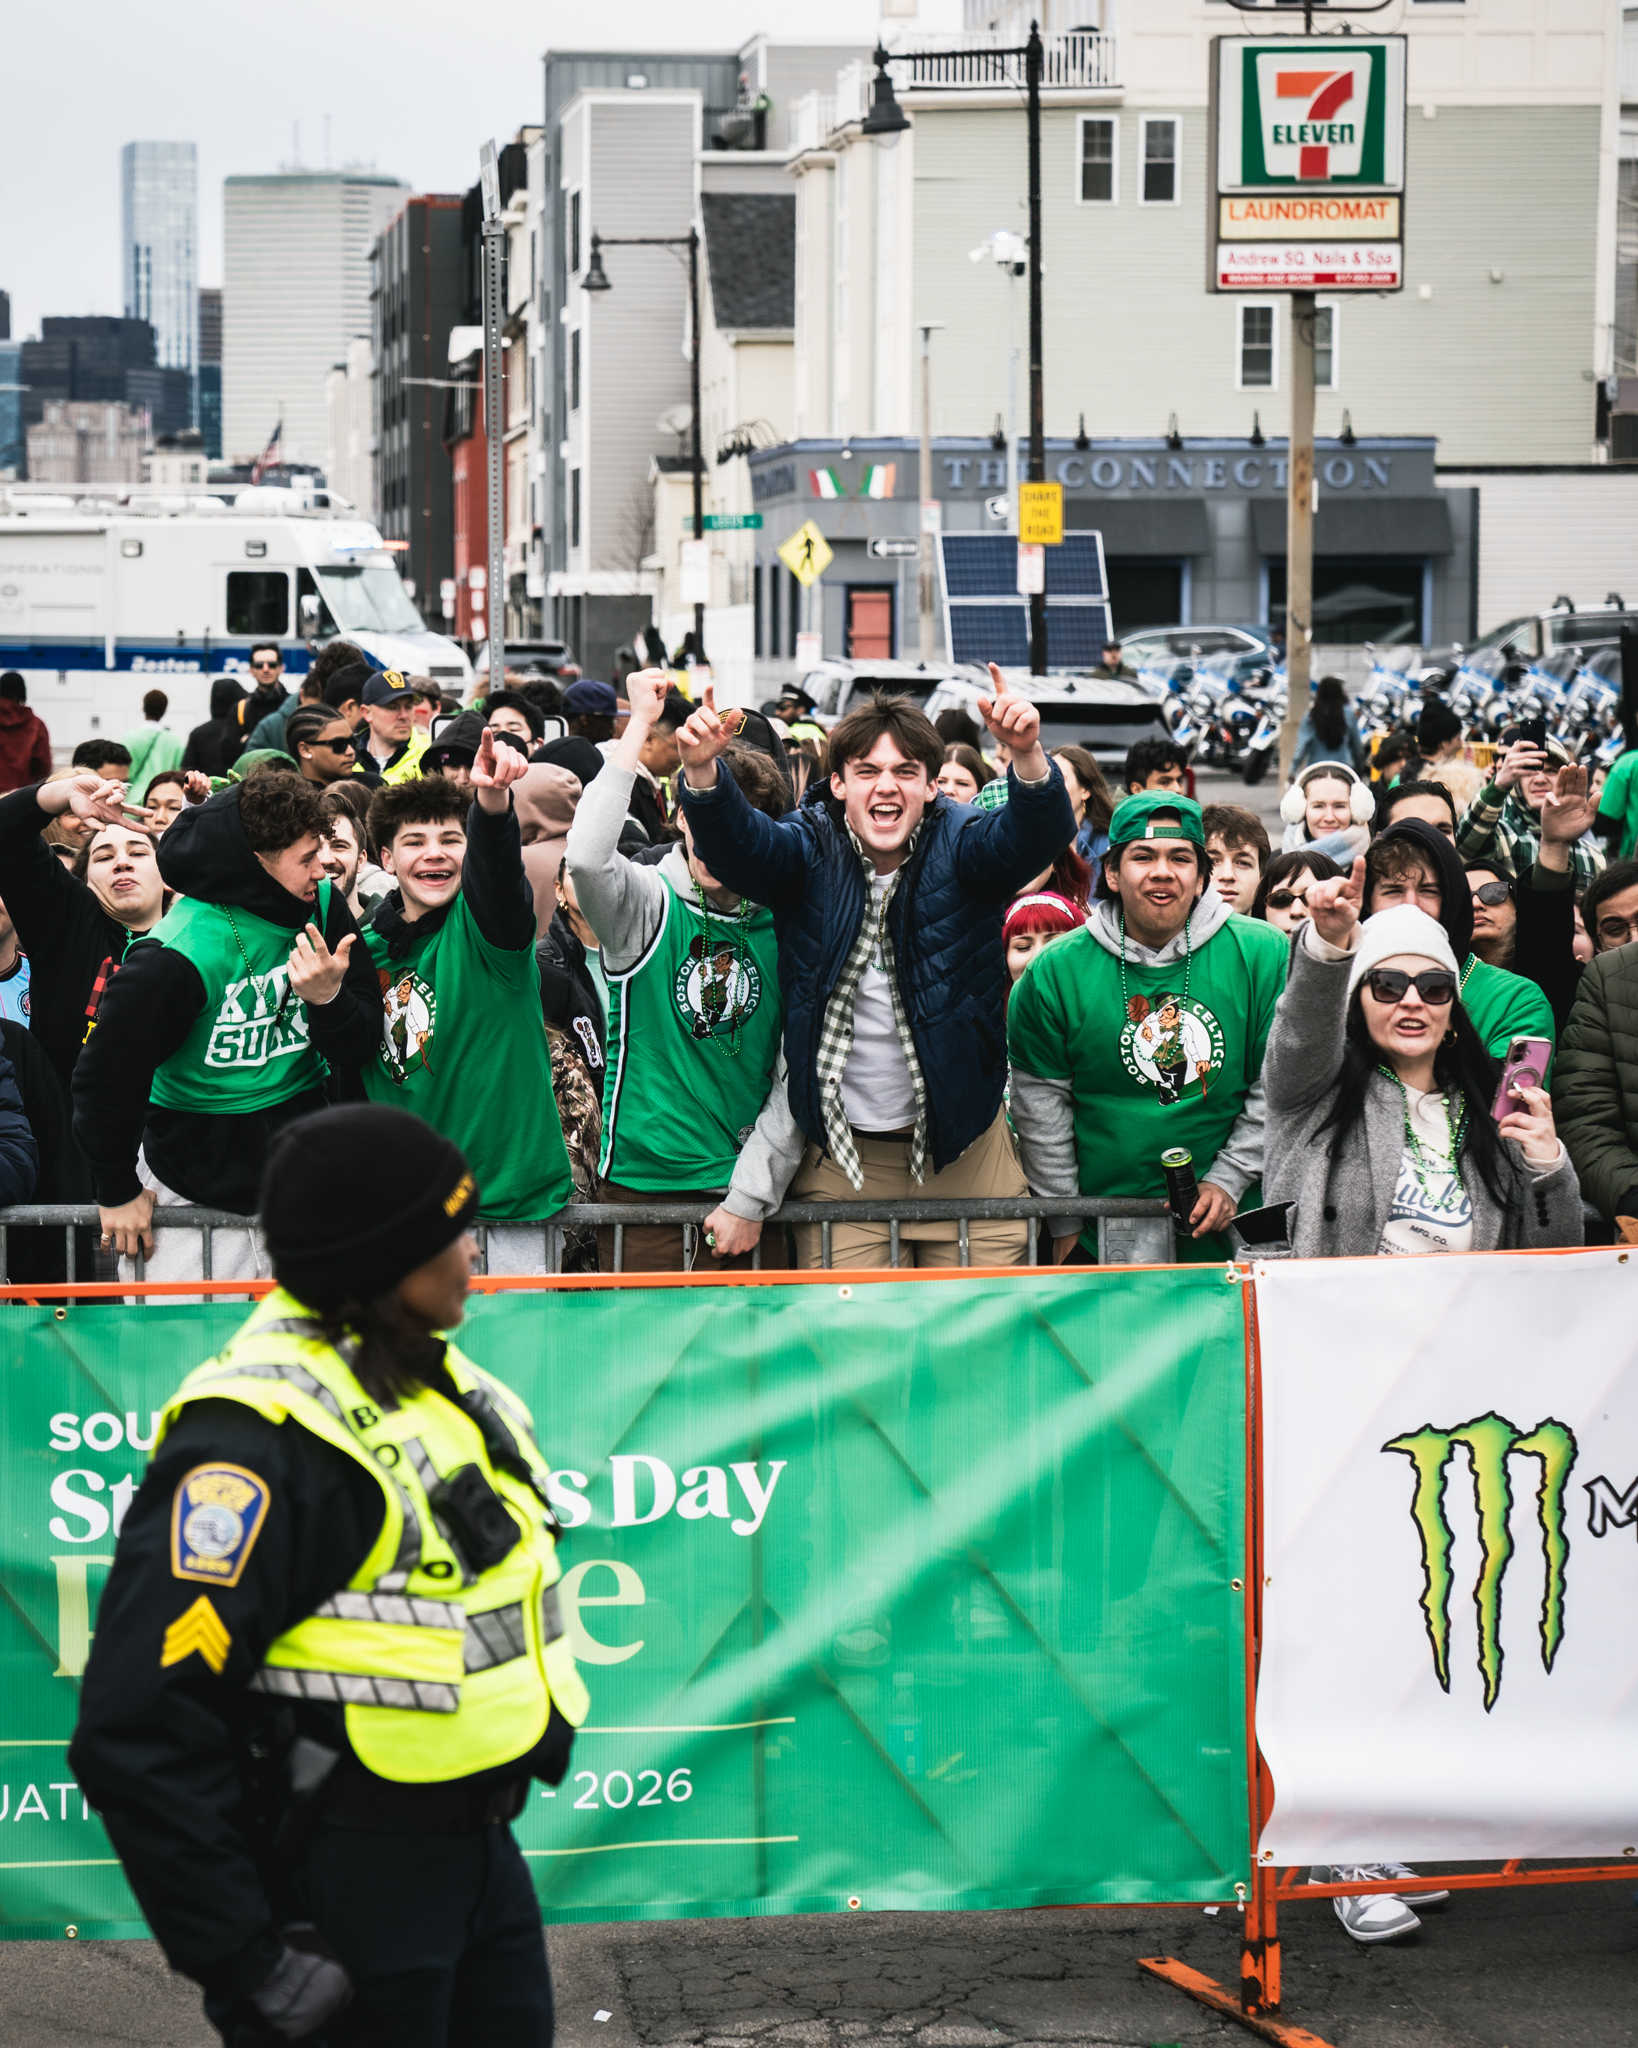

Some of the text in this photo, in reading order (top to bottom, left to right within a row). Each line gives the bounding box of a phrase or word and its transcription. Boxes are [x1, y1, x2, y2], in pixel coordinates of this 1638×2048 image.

[1276, 70, 1354, 179] 7
[1228, 201, 1390, 221] LAUNDROMAT
[1228, 250, 1280, 266] Andrew
[1313, 250, 1347, 266] Nails
[1352, 250, 1361, 265] &
[1367, 250, 1392, 269] Spa
[1057, 456, 1392, 489] CONNECTON
[131, 655, 201, 674] Boston
[676, 957, 697, 1014] BOSTON
[742, 957, 760, 1015] CELTICS
[1120, 1022, 1149, 1085] BOSTON
[1192, 1003, 1225, 1069] CELTICS
[1409, 1225, 1448, 1247] MFG. CO.
[49, 1411, 163, 1452] SOU
[609, 1455, 788, 1536] Day
[573, 1768, 693, 1809] 2026
